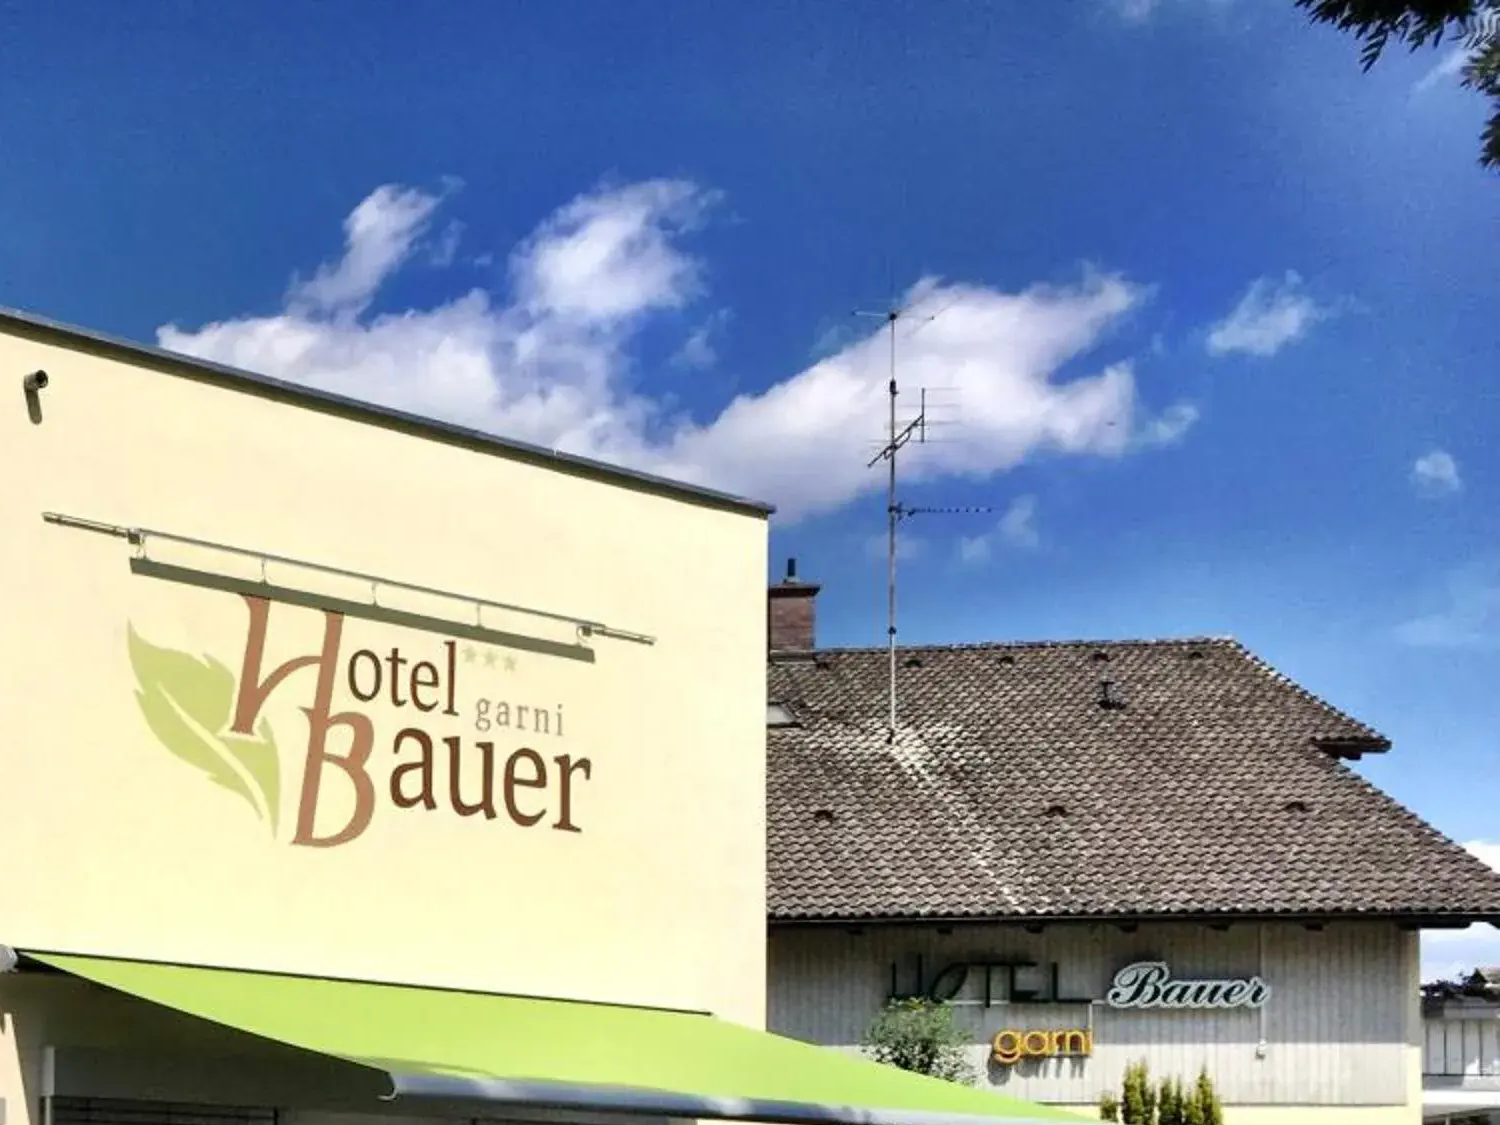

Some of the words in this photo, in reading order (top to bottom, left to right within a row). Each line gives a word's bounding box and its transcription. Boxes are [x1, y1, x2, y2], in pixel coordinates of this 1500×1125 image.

[229, 592, 460, 736] Hotel
[474, 696, 565, 738] garni
[289, 705, 592, 849] Bauer
[1107, 961, 1271, 1009] Bauer
[993, 1029, 1093, 1064] garni
